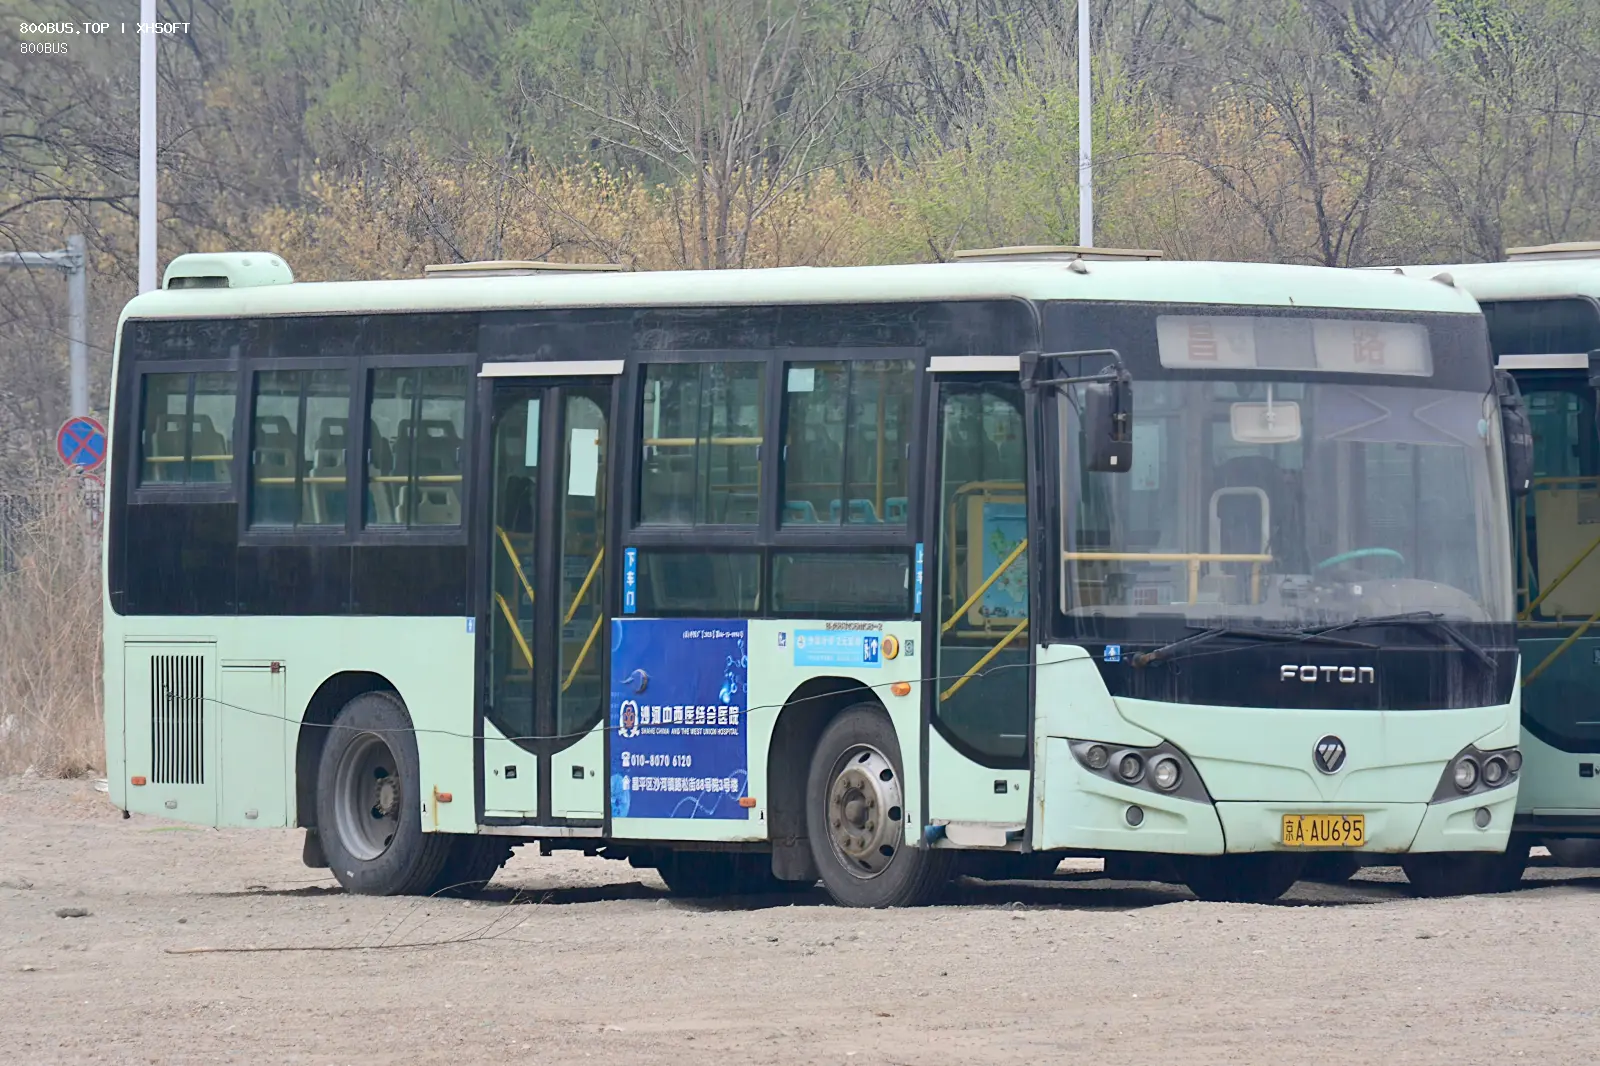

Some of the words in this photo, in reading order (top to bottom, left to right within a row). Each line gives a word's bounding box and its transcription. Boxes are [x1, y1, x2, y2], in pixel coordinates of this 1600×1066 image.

[626, 551, 636, 606] 下车门
[1280, 664, 1375, 684] FOTON
[640, 705, 740, 726] 沙河中西医结合医院
[641, 727, 656, 735] SHAHE
[656, 727, 670, 735] CHINA
[671, 727, 680, 735] AND
[681, 727, 690, 735] THE
[703, 728, 717, 736] UNION
[717, 728, 739, 736] HOSPITAL
[630, 753, 670, 767] 010-8070
[672, 754, 692, 768] 6120
